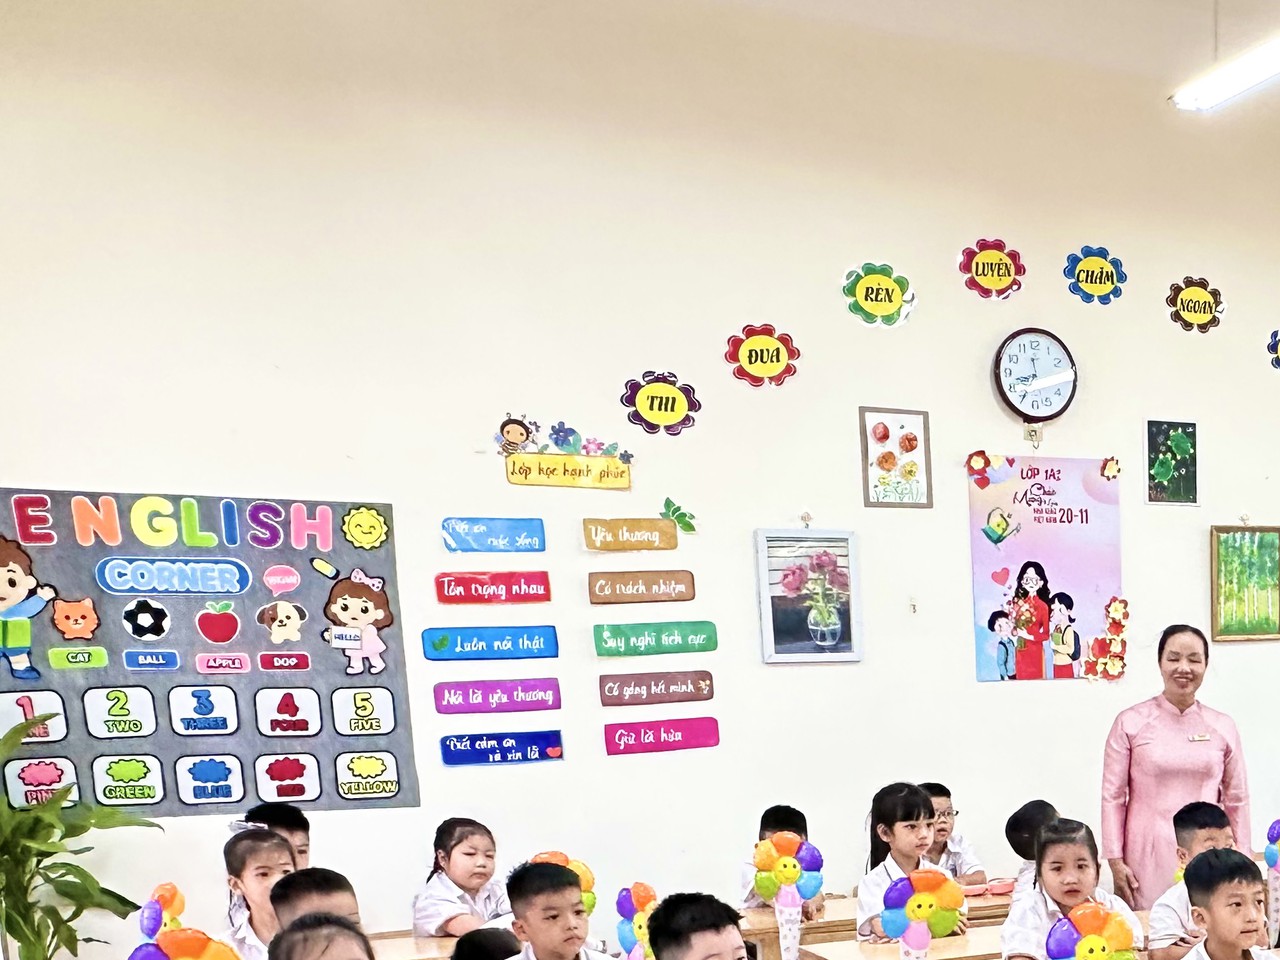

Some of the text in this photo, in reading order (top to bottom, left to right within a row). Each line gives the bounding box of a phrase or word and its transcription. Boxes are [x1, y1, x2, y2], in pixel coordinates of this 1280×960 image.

[974, 257, 1012, 282] LUYỆN
[1076, 265, 1115, 287] CHĂM
[863, 281, 894, 303] RÈN
[1178, 296, 1215, 315] NGOAN
[747, 346, 781, 365] ĐUA
[646, 394, 677, 413] THI
[510, 460, 532, 480] Lớp
[538, 461, 558, 478] học
[563, 462, 593, 480] hạnh
[1020, 464, 1040, 480] LỚP
[11, 493, 333, 552] ENGLISH
[1059, 508, 1089, 525] 20-11
[588, 524, 660, 547] Yêu thương
[105, 559, 241, 592] CORNER
[440, 577, 546, 600] Tôn trọng nhau
[595, 579, 687, 597] Có trách nhiệm
[455, 635, 487, 653] Luôn
[519, 633, 545, 653] thật
[602, 631, 625, 651] Suy
[630, 631, 656, 650] nghĩ
[66, 651, 93, 664] CAT
[138, 654, 166, 665] BALL
[273, 657, 299, 667] DOG
[513, 686, 554, 705] thương
[604, 682, 621, 696] Cố
[16, 695, 35, 721] 1
[105, 689, 130, 716] 2
[191, 689, 215, 716] 3
[276, 692, 300, 717] 4
[353, 691, 375, 718] 5
[104, 719, 143, 733] TWO
[180, 717, 228, 730] THREE
[349, 718, 381, 731] FIVE
[507, 749, 522, 761] xin
[103, 785, 156, 800] GREEN
[339, 780, 398, 795] YELLOW
